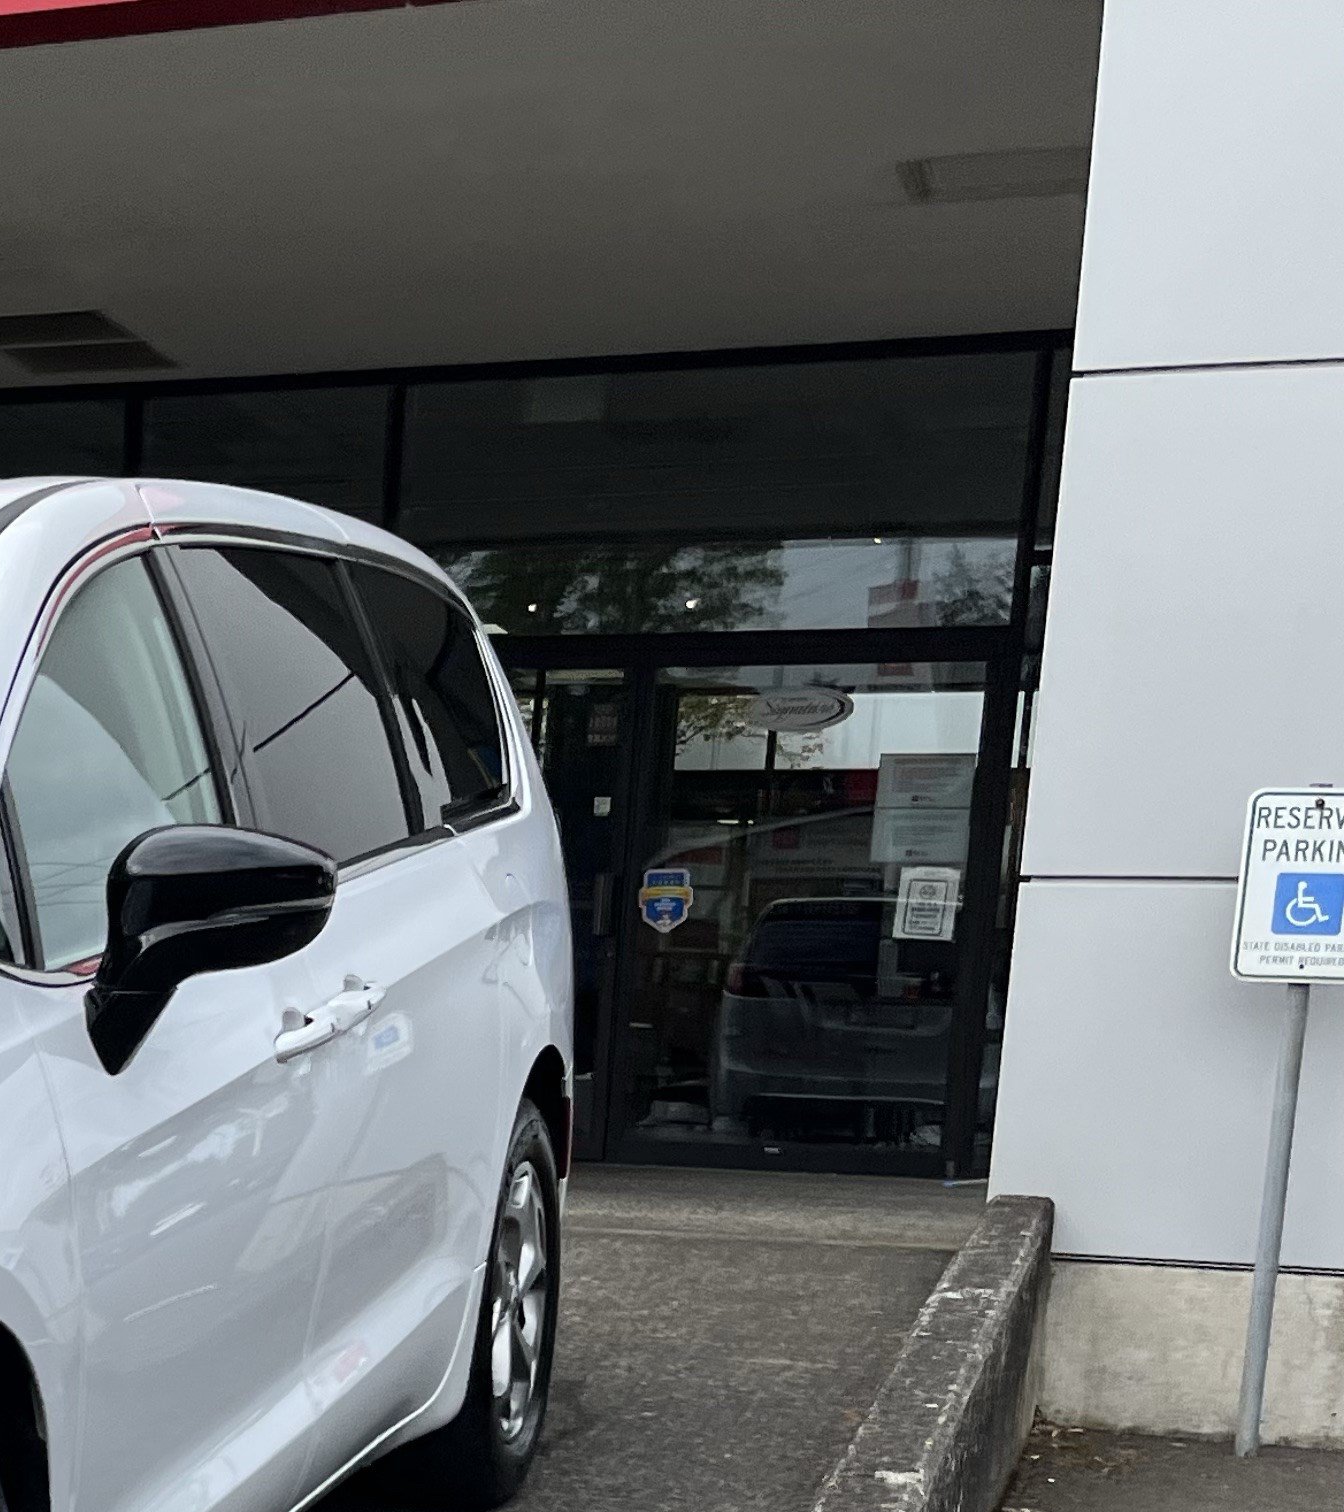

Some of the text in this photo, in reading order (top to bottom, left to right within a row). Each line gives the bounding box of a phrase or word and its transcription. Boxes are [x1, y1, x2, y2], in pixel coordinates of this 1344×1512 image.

[1243, 941, 1270, 952] STATE
[1274, 942, 1321, 953] DISABLED
[1259, 955, 1294, 965] PERMIT
